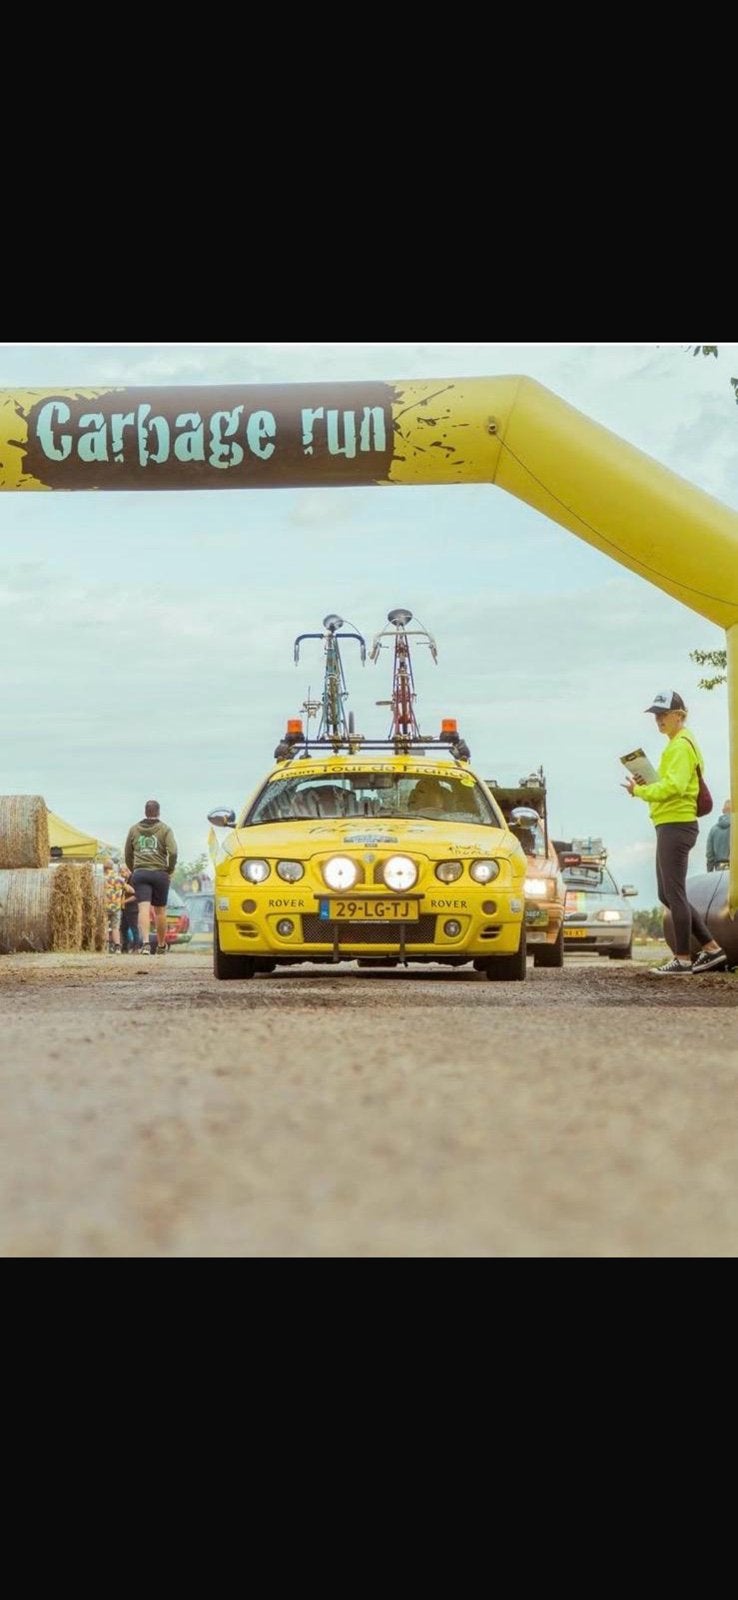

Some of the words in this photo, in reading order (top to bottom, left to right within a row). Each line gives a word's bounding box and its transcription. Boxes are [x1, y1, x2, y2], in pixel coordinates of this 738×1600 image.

[36, 401, 277, 469] Carbage
[302, 406, 386, 459] run
[322, 764, 363, 773] Tour
[371, 764, 397, 773] de
[268, 898, 305, 908] ROVER
[430, 899, 468, 909] ROVER
[336, 902, 410, 918] 29-LG-TJ
